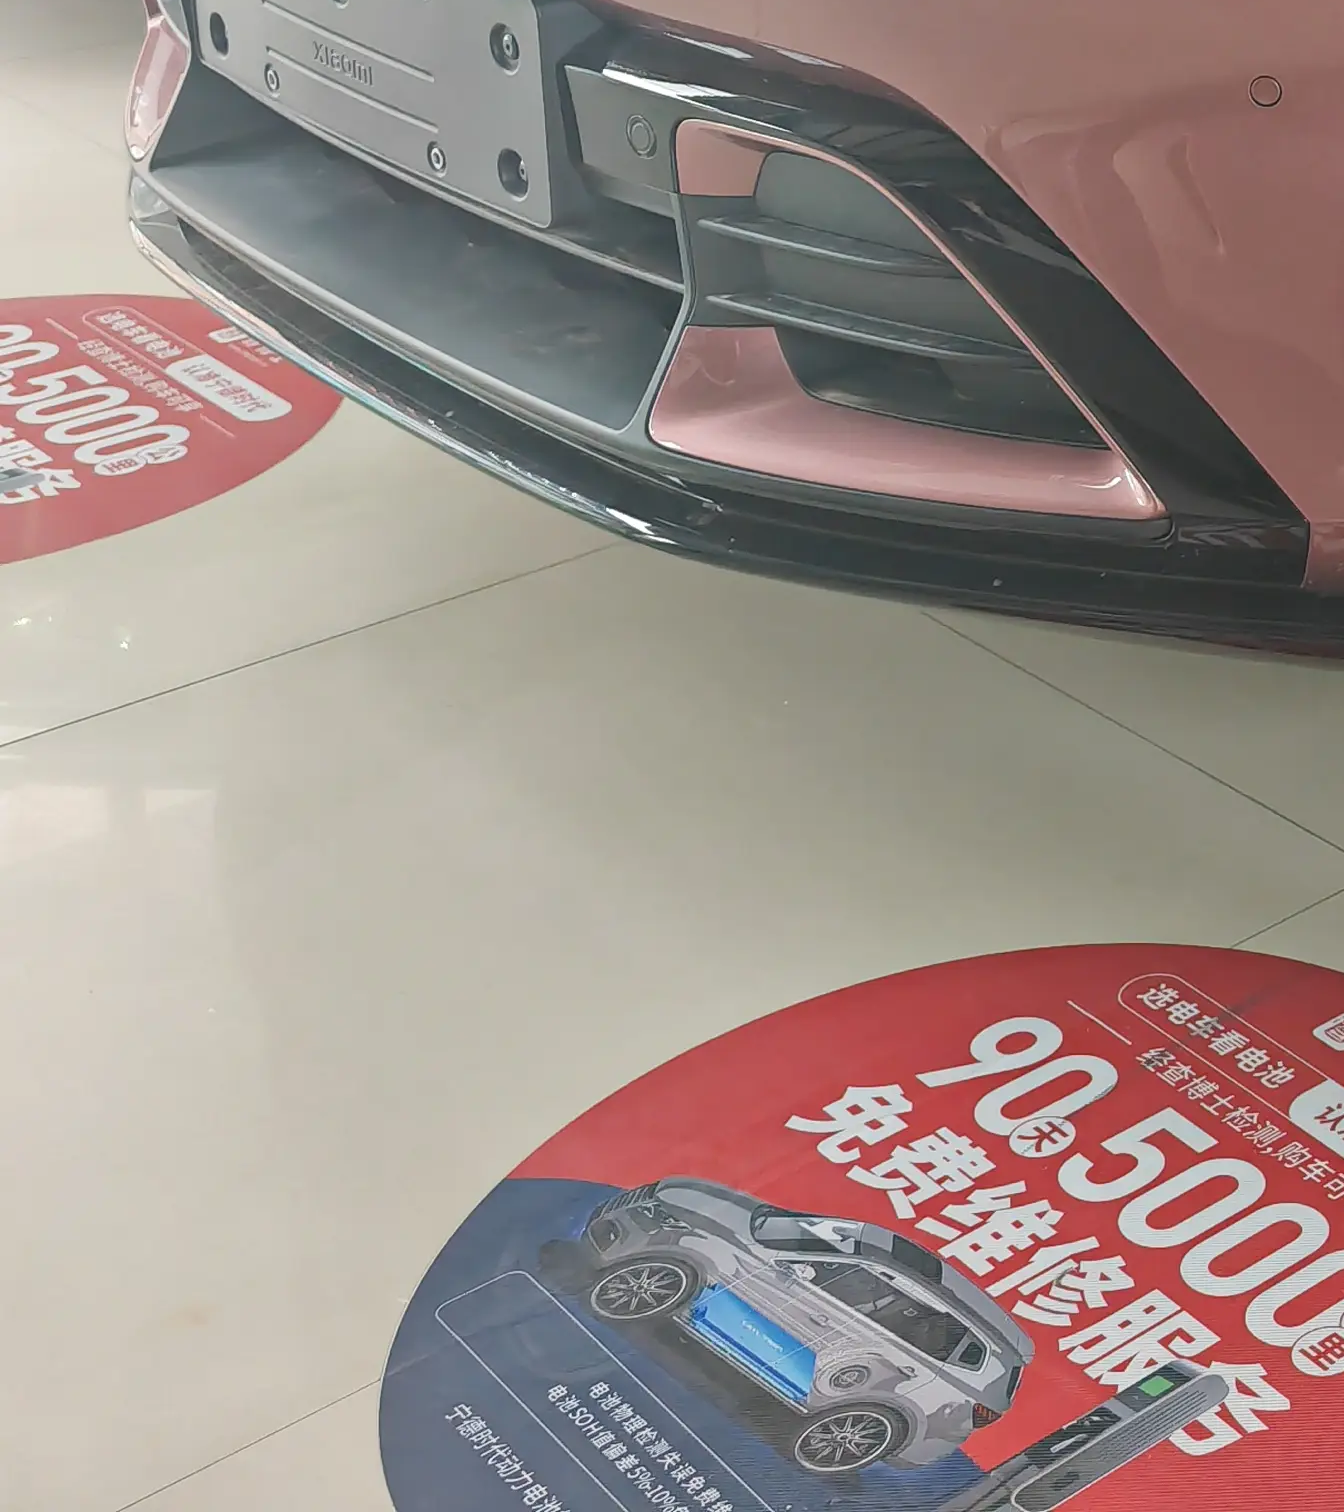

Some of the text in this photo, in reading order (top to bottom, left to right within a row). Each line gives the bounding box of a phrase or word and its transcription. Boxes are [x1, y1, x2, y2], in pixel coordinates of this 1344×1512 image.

[1136, 983, 1296, 1089] 选电车看电池
[785, 1084, 1292, 1456] 免费维修服务
[444, 1403, 571, 1512] 宁德时代动力电池
